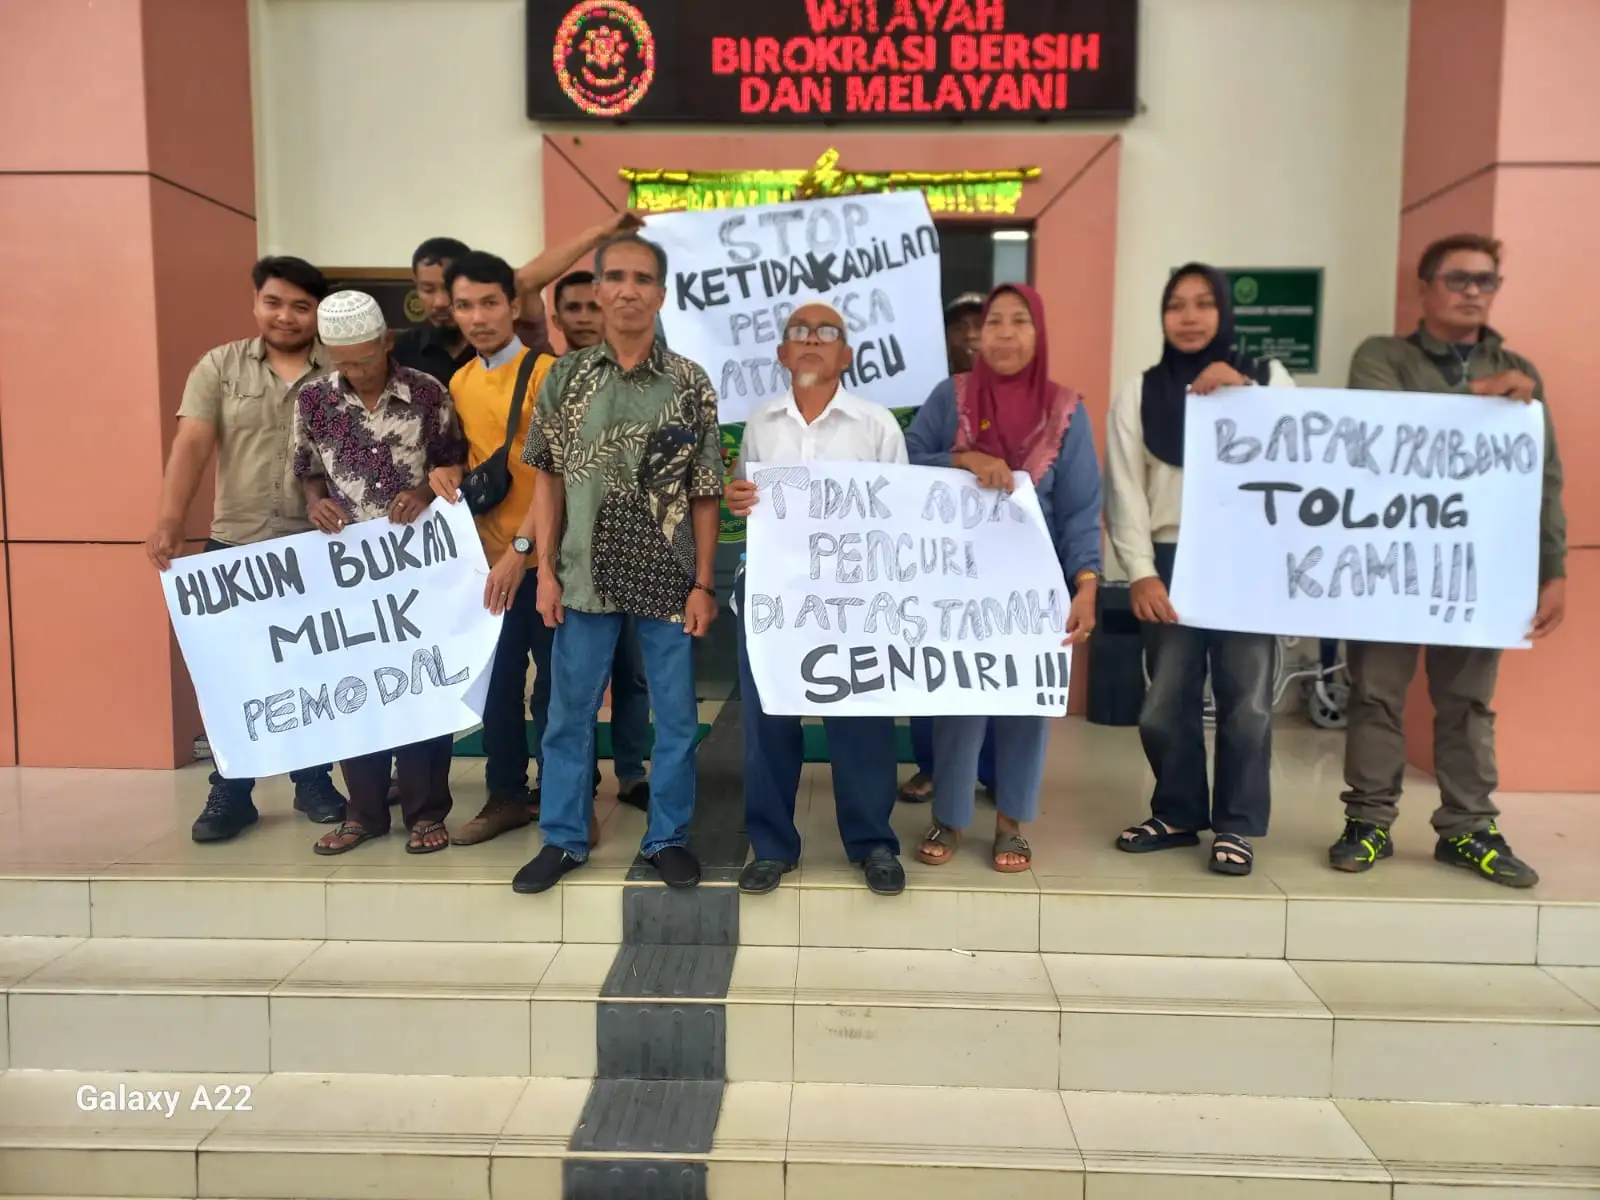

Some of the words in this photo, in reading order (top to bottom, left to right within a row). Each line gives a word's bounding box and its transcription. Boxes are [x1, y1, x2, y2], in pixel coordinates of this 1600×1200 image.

[711, 35, 937, 74] BIROKRASI
[950, 32, 1101, 71] BERSIH
[740, 75, 832, 114] DAN
[846, 72, 1068, 113] MELAYANI
[719, 203, 869, 264] STOP
[1214, 411, 1384, 475] BAPAK
[752, 466, 893, 520] TIDAK
[174, 546, 306, 616] HUKUM
[327, 510, 458, 588] BUKAN
[809, 530, 979, 583] PENCURI
[268, 588, 422, 663] MILIK
[752, 594, 785, 634] DI
[795, 592, 928, 648] ATAS
[931, 588, 1063, 642] TANAH
[243, 644, 470, 741] PEMODAL
[800, 644, 1018, 704] SENDIRI
